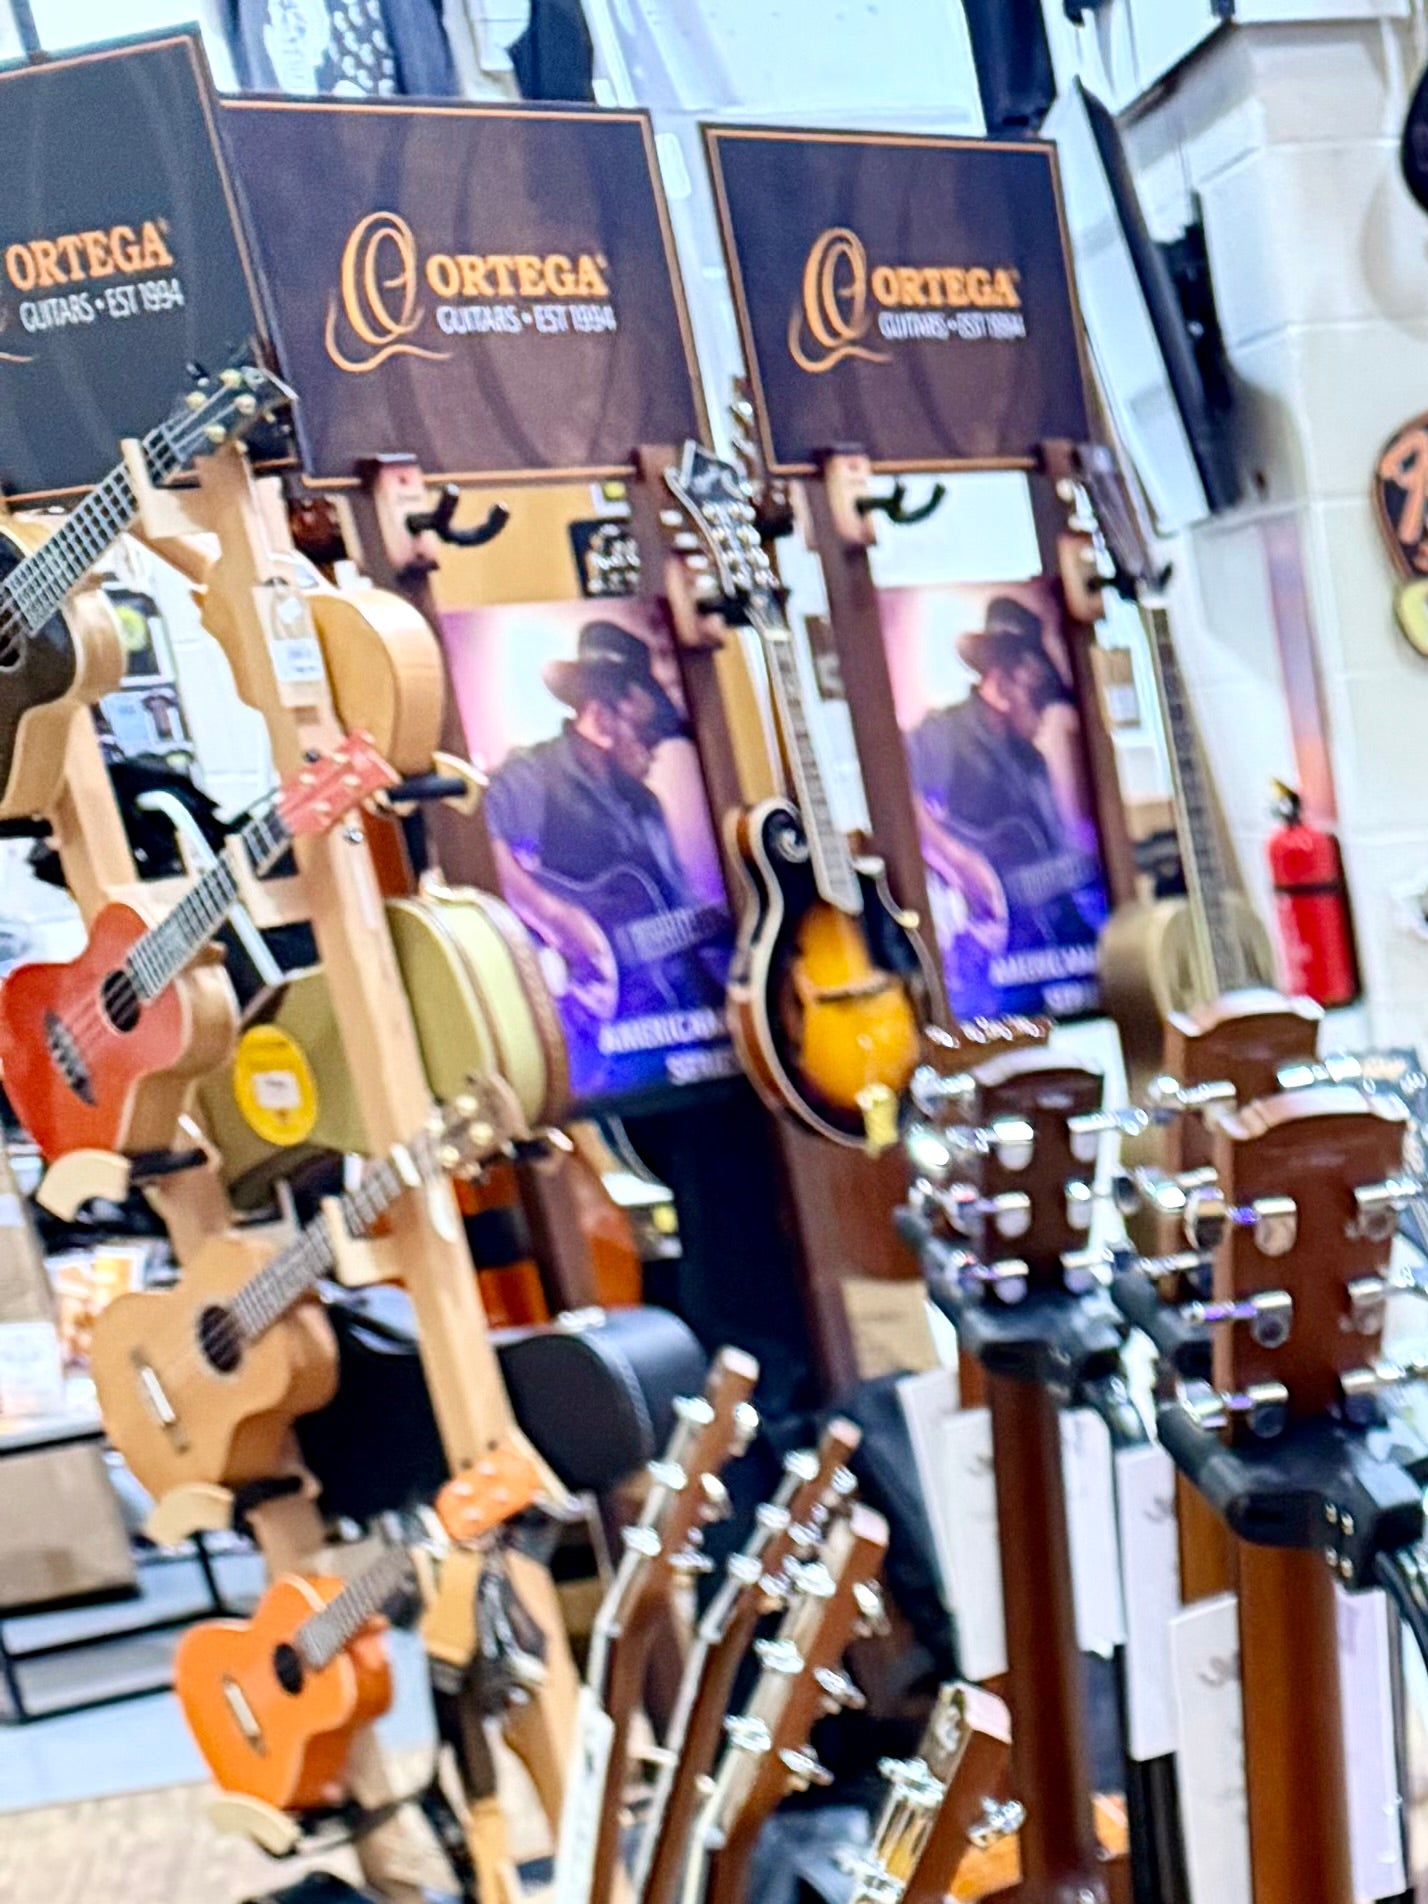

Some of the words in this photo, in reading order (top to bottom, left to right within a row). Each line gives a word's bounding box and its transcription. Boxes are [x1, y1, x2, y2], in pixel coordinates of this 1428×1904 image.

[4, 221, 174, 291] ORTEGA
[425, 254, 609, 298] ORTEGA
[19, 292, 95, 333] GUITARS
[104, 284, 139, 319] EST
[871, 266, 1022, 308] ORTEGA
